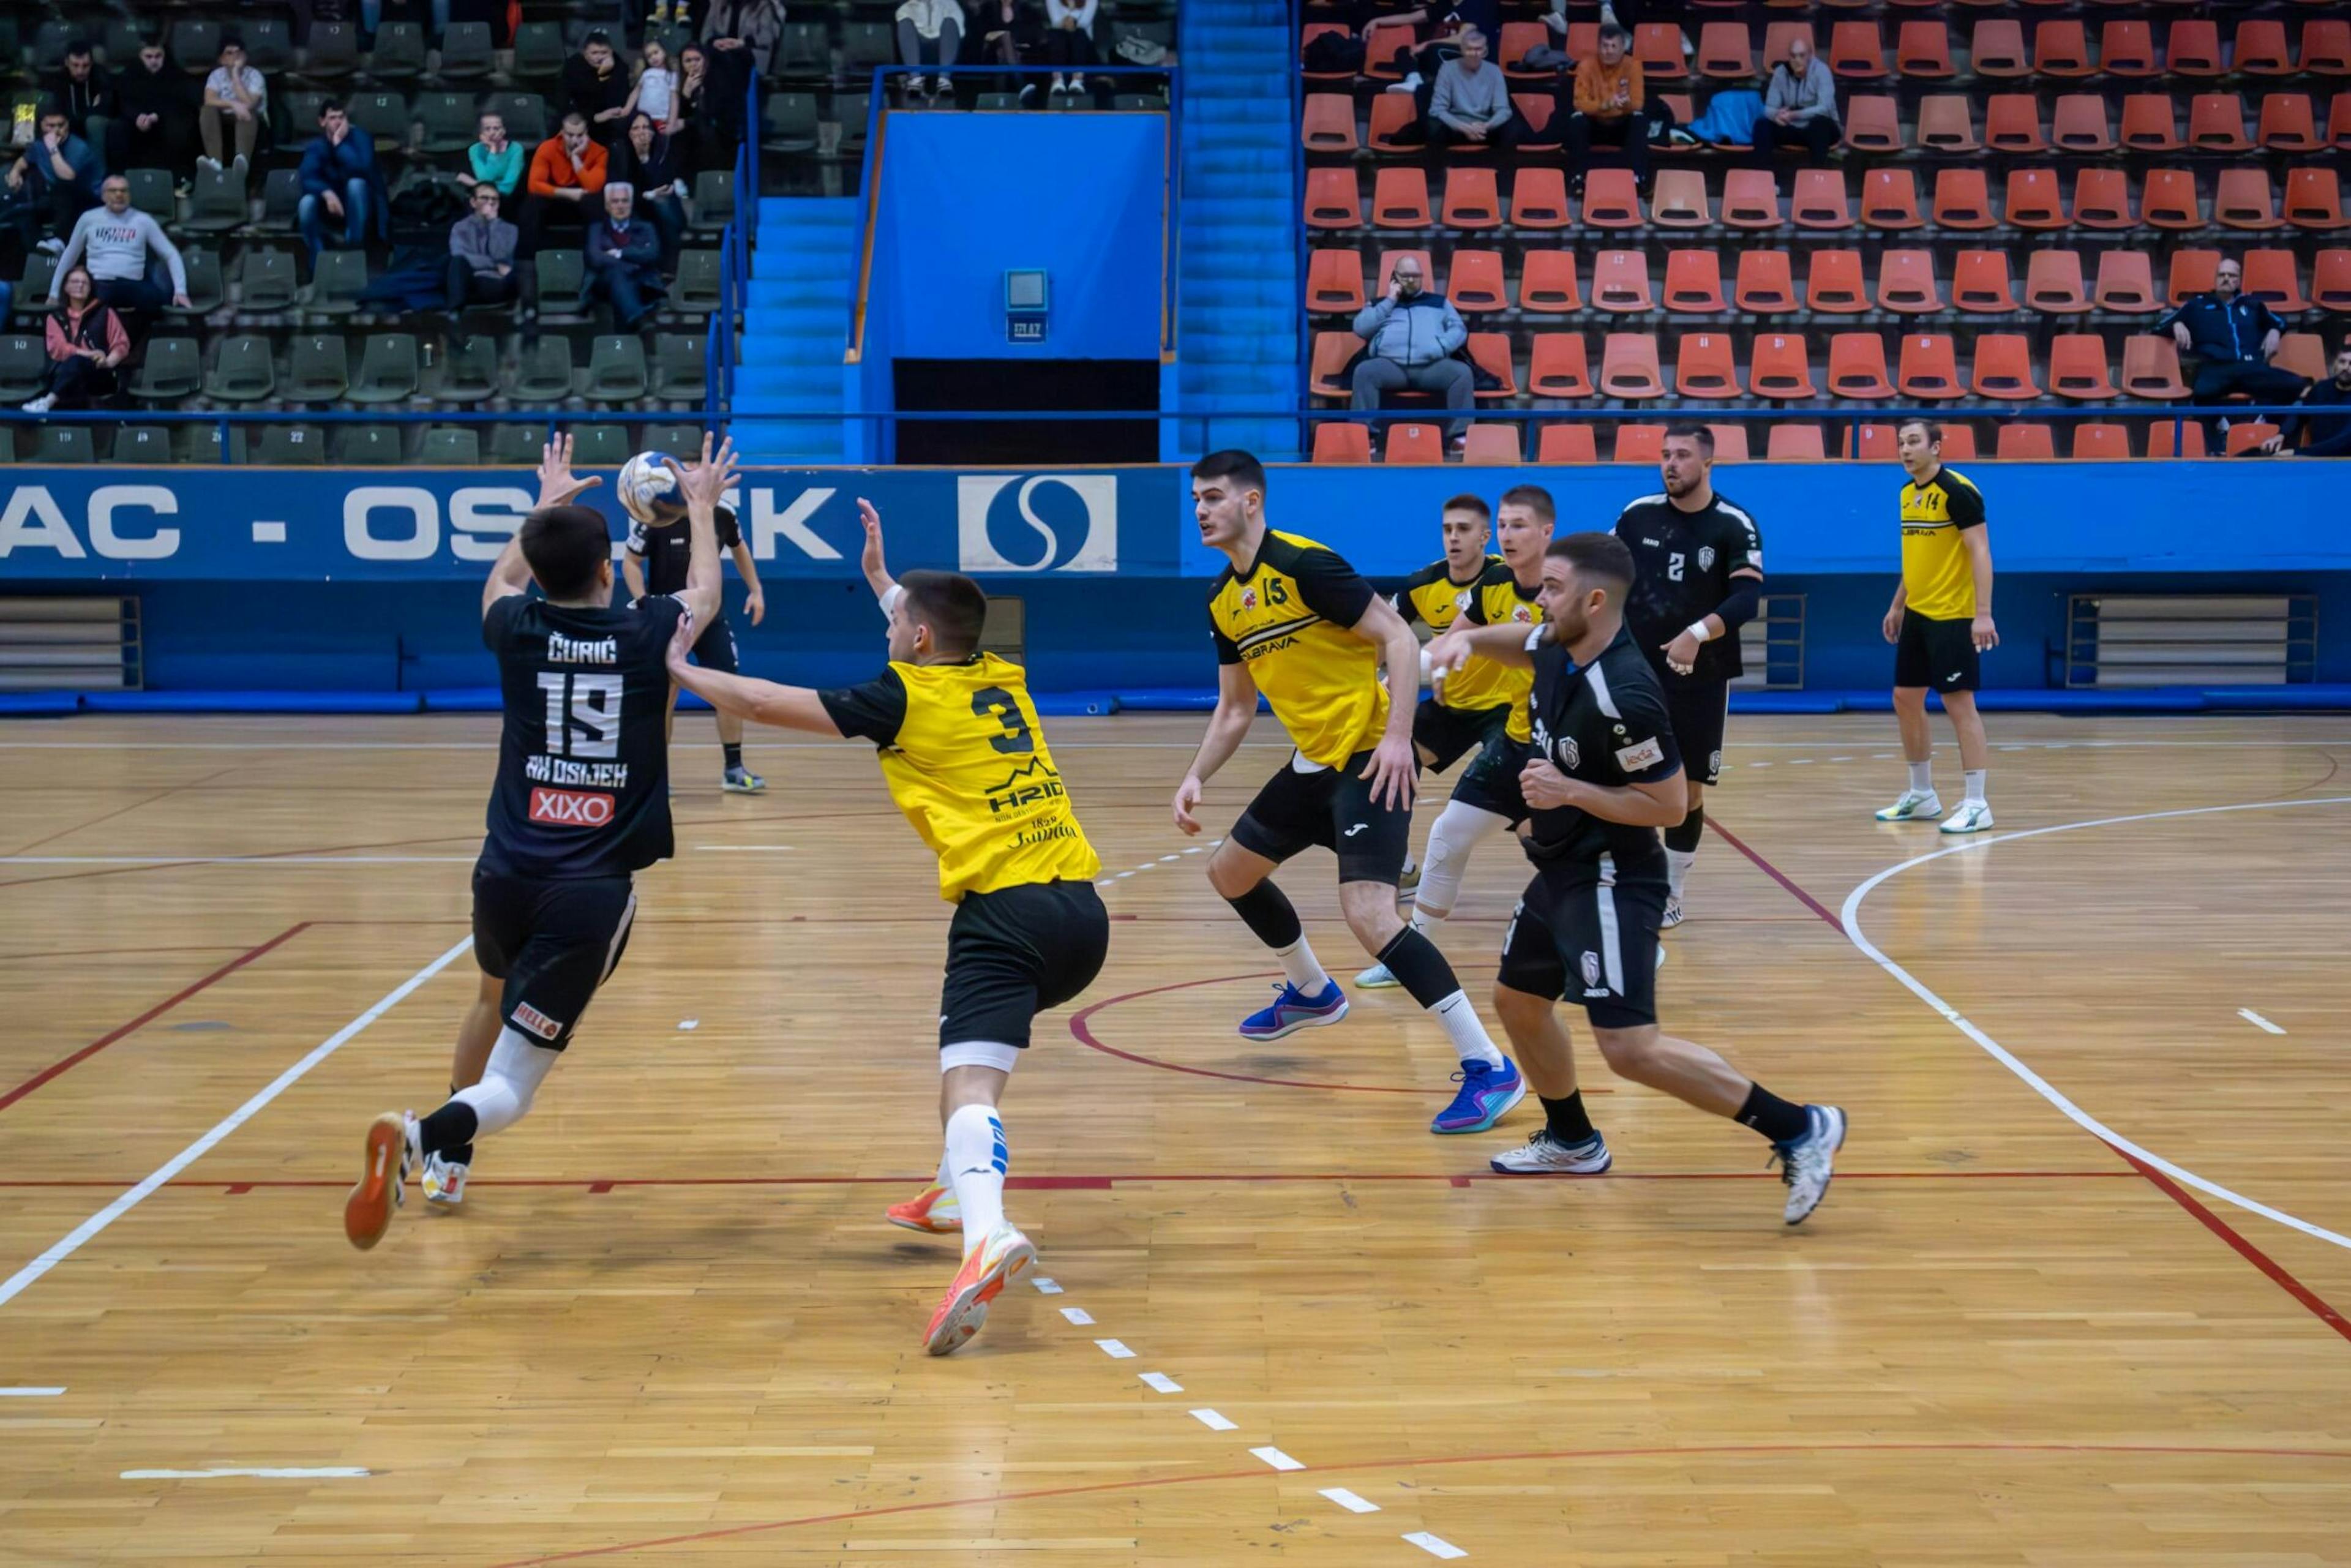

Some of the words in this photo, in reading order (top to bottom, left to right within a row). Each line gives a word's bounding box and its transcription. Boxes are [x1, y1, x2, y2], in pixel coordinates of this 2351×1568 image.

[1926, 492, 1940, 510] 14
[0, 486, 180, 558] AC
[343, 487, 844, 560] OSK
[1668, 552, 1685, 582] 2
[1263, 578, 1288, 607] 15
[537, 672, 623, 757] 19
[971, 686, 1035, 754] 3
[536, 792, 609, 822] XIXO
[989, 782, 1063, 812] HRID
